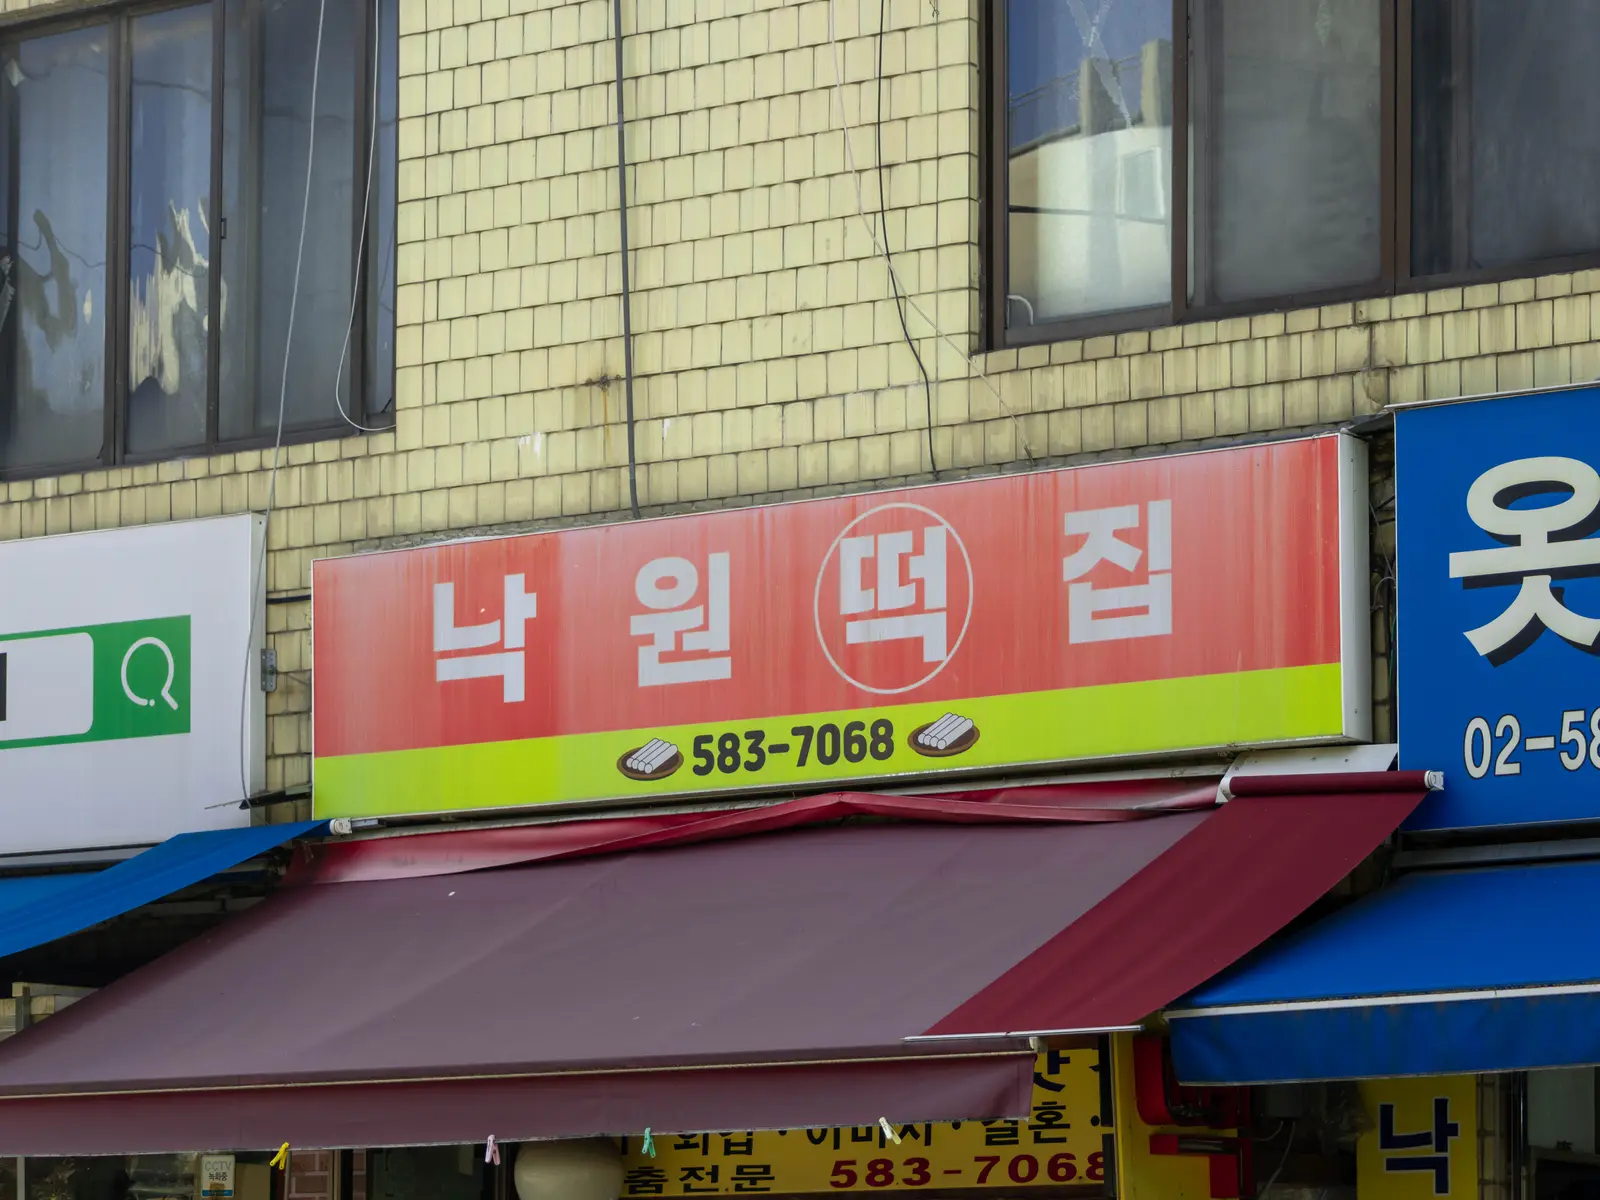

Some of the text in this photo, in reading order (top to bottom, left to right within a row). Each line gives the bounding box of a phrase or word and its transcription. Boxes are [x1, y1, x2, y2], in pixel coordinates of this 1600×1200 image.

[692, 718, 896, 775] 583-7068
[204, 1160, 232, 1172] CCTV
[1379, 1097, 1460, 1195] 낙
